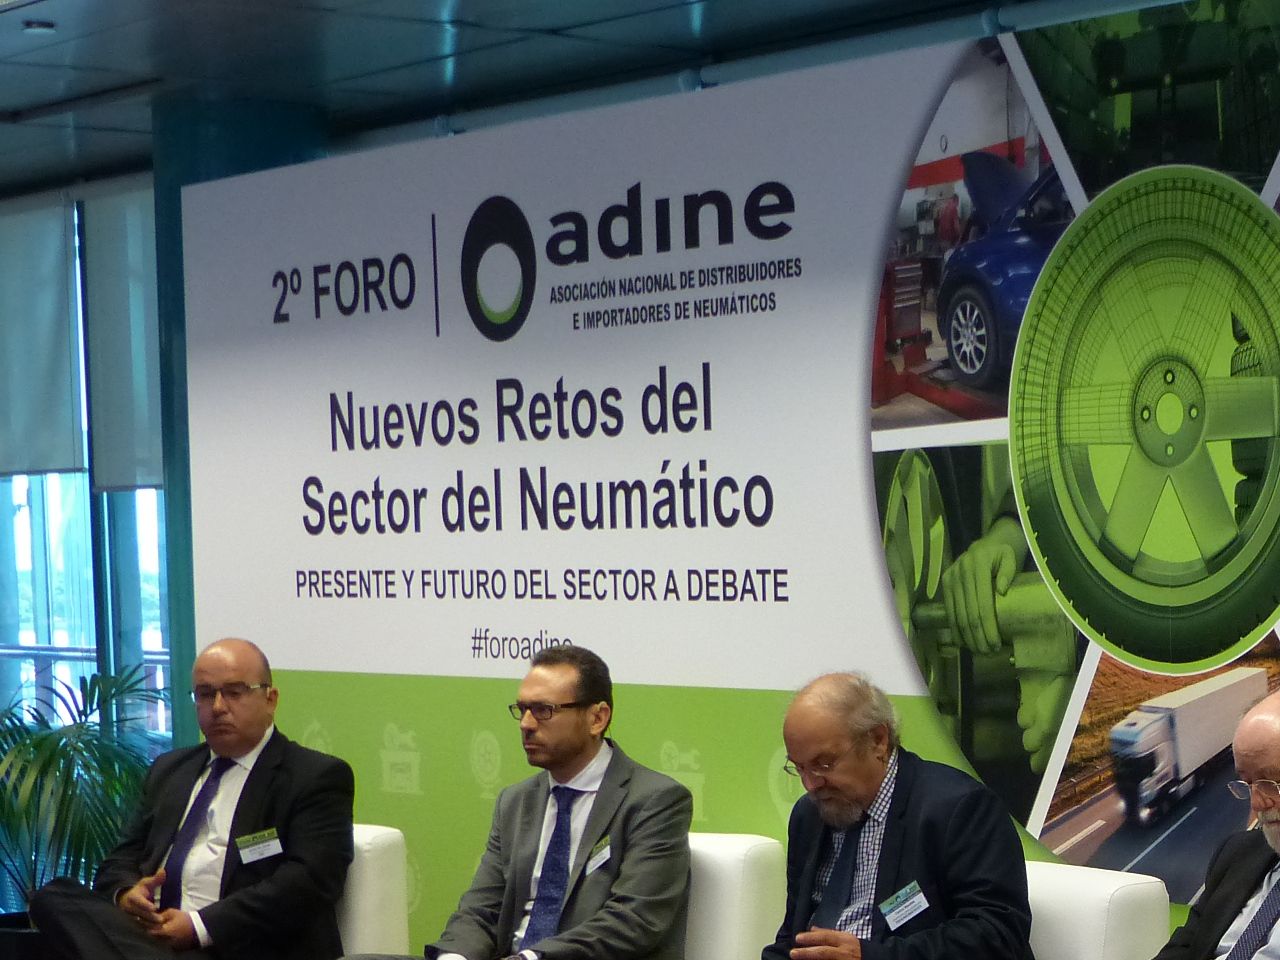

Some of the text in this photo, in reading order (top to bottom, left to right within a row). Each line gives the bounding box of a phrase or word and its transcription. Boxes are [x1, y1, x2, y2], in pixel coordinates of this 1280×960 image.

[313, 252, 416, 319] FORO
[550, 258, 801, 304] ASOCIACIÓN NACIONAL DE DISTRIBUIDORES
[573, 291, 776, 330] E IMPORTADORES DE NEUMÁTICOS
[329, 361, 713, 452] Nuevos Retos del
[302, 460, 774, 535] Sector del Neumático
[295, 568, 789, 602] PRESENTE Y FUTURO DEL SECTOR A DEBATE
